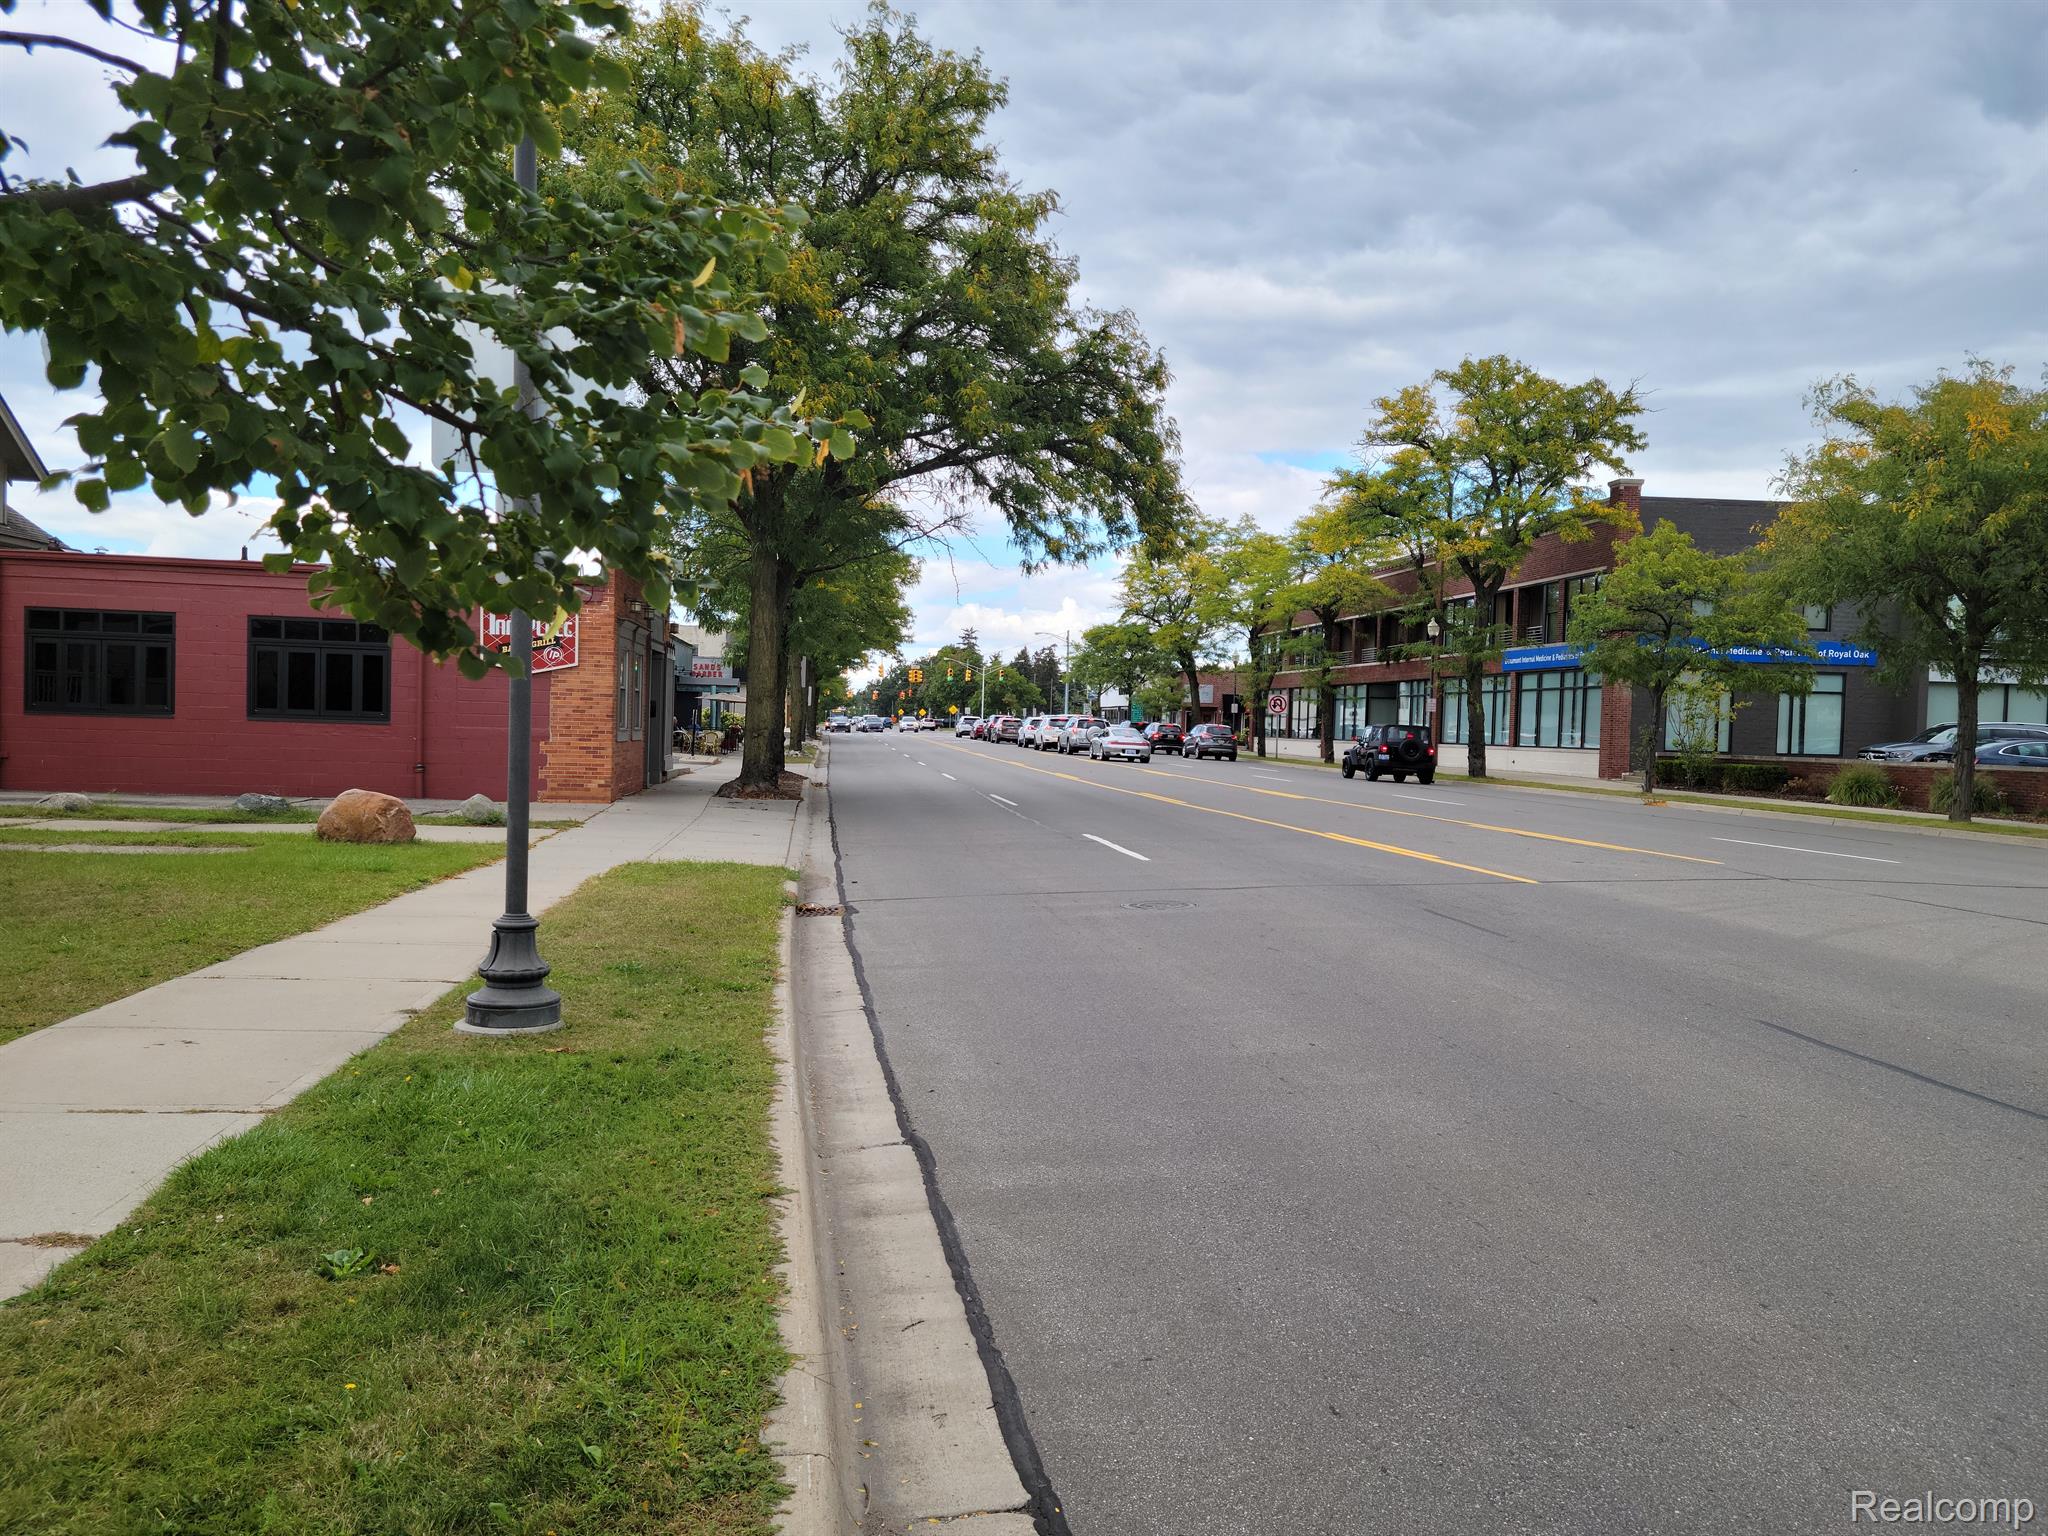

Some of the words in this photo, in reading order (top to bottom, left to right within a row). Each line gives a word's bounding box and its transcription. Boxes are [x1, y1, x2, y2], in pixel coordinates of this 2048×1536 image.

[531, 637, 556, 648] GRILL
[1828, 650, 1851, 660] Royal
[1853, 650, 1869, 658] Oak
[693, 663, 721, 671] SANDS
